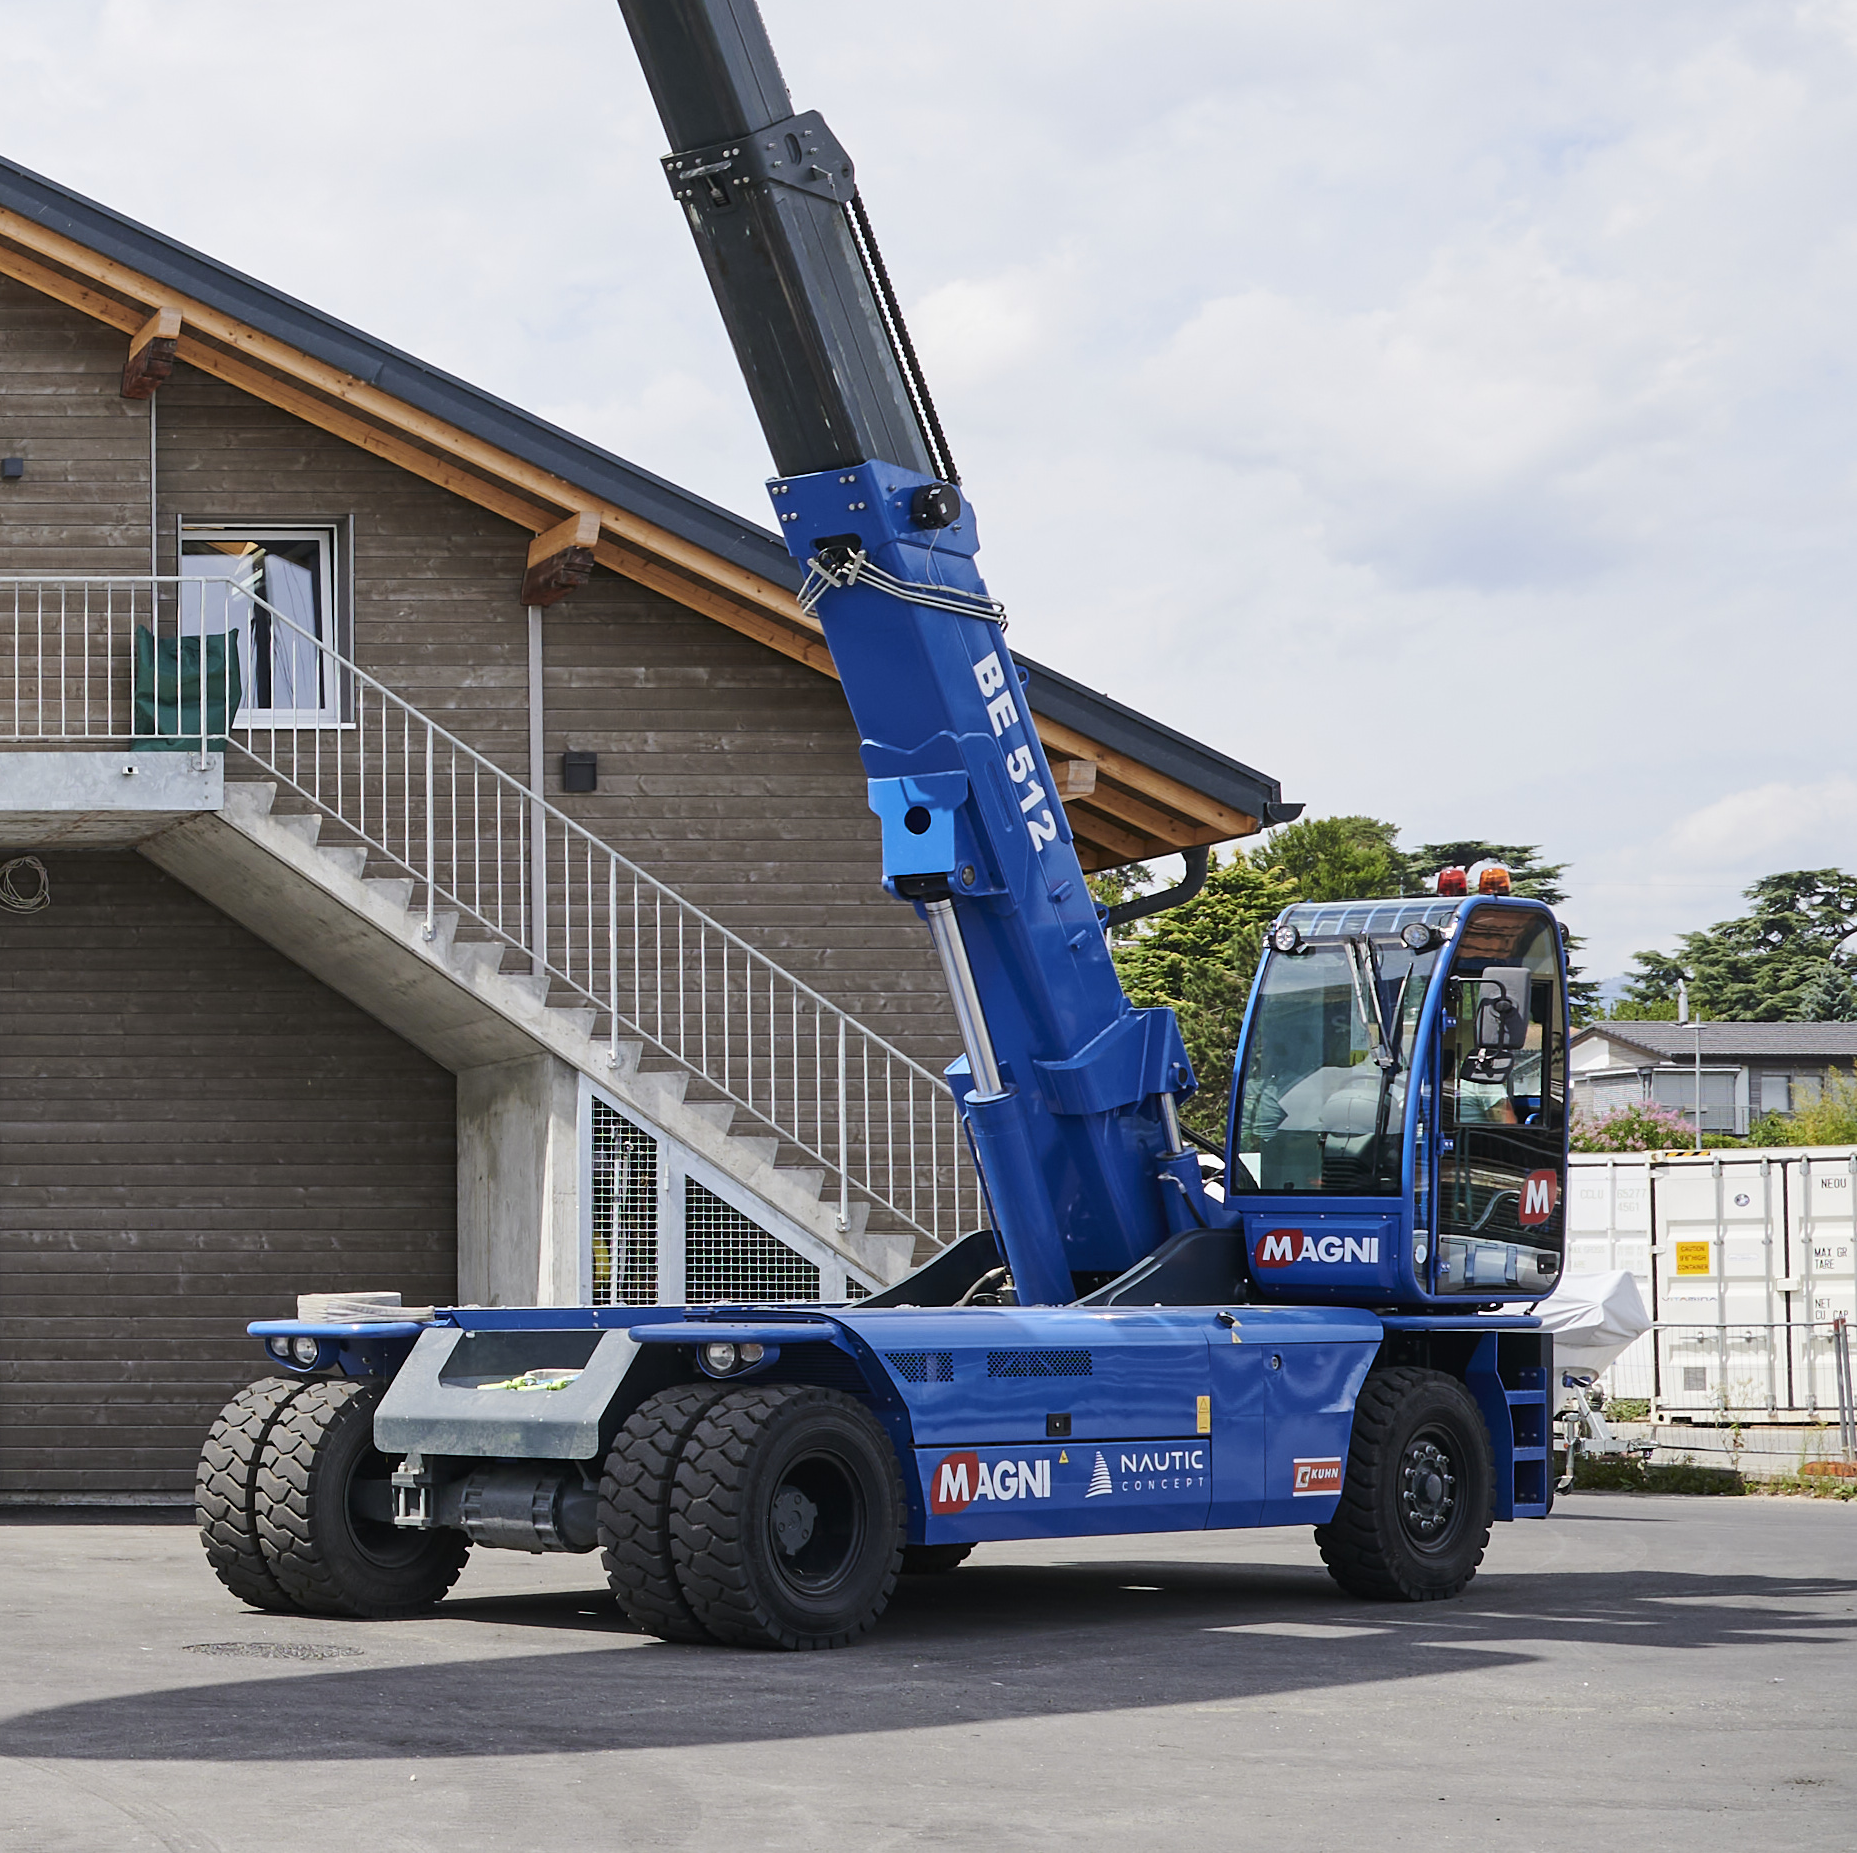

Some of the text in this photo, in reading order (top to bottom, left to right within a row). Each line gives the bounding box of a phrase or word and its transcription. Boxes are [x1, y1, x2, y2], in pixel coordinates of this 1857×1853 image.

[973, 650, 1057, 853] BE 512
[1821, 1178, 1847, 1188] NEOU
[1525, 1179, 1549, 1214] M
[1262, 1235, 1379, 1264] MAGNI
[1814, 1258, 1835, 1269] TARE
[1814, 1298, 1830, 1310] NET
[1121, 1450, 1204, 1473] NAUTIC
[938, 1459, 1051, 1503] MAGNI
[1310, 1467, 1339, 1479] KUHN
[1121, 1476, 1204, 1492] CONCEPT
